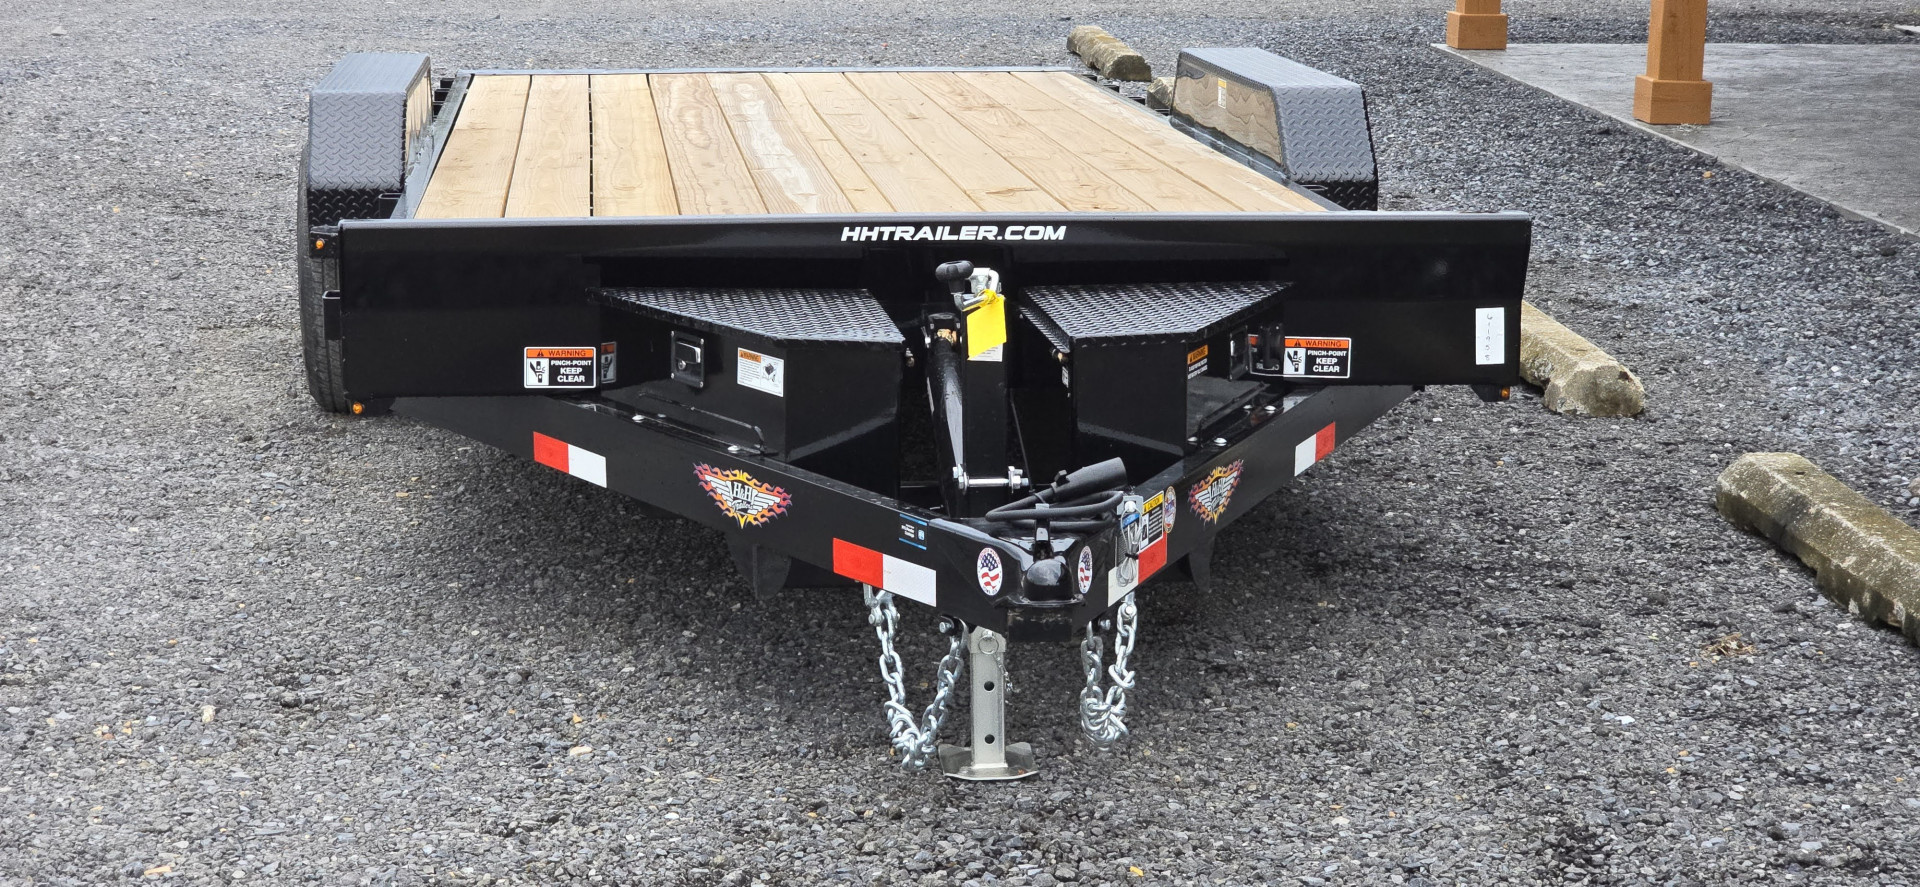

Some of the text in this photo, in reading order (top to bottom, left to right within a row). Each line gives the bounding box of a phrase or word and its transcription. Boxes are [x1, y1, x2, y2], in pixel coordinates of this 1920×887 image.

[840, 225, 1067, 242] HHTRAILER.COM
[548, 349, 586, 357] WARNING
[1315, 357, 1338, 365] KEEP
[1312, 365, 1340, 373] CLEAR
[557, 375, 586, 383] CLEAR
[733, 481, 753, 501] H&H
